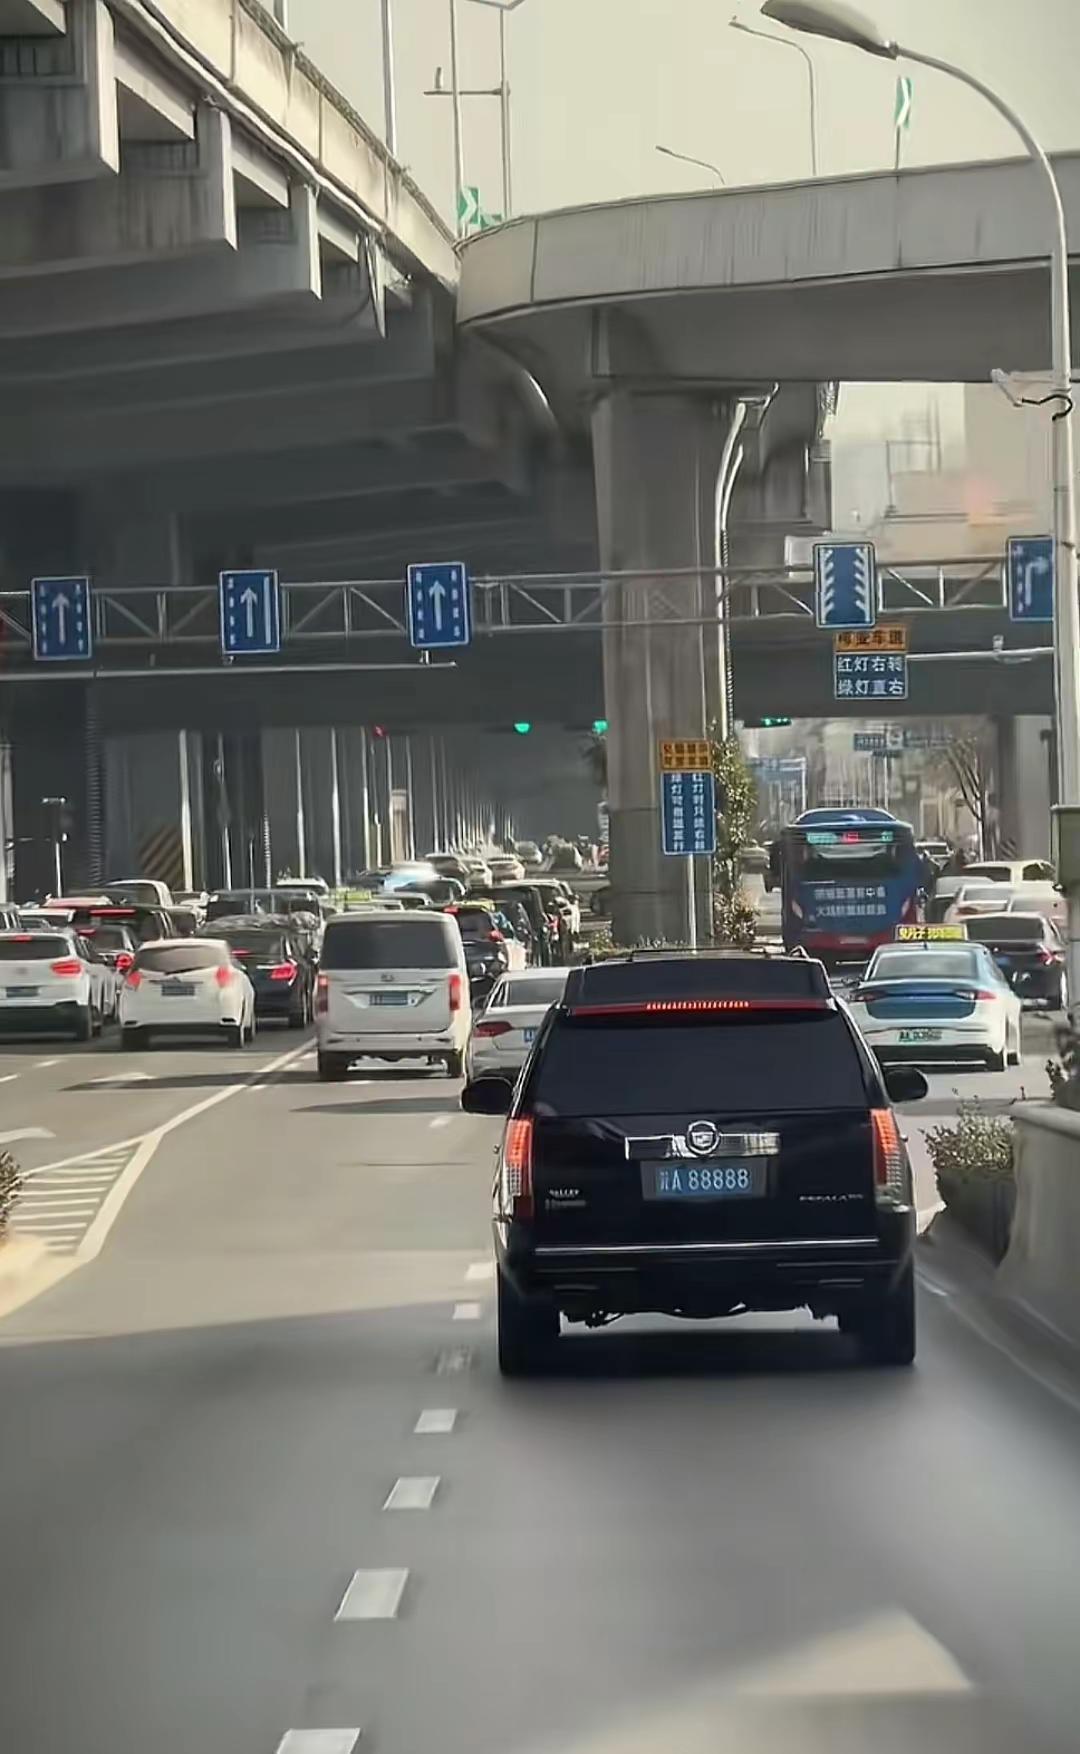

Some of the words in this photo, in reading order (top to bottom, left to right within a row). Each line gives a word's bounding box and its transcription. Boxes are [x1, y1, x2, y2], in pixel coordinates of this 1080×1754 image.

[838, 656, 902, 672] 红灯右转
[838, 678, 904, 695] 绿灯直右
